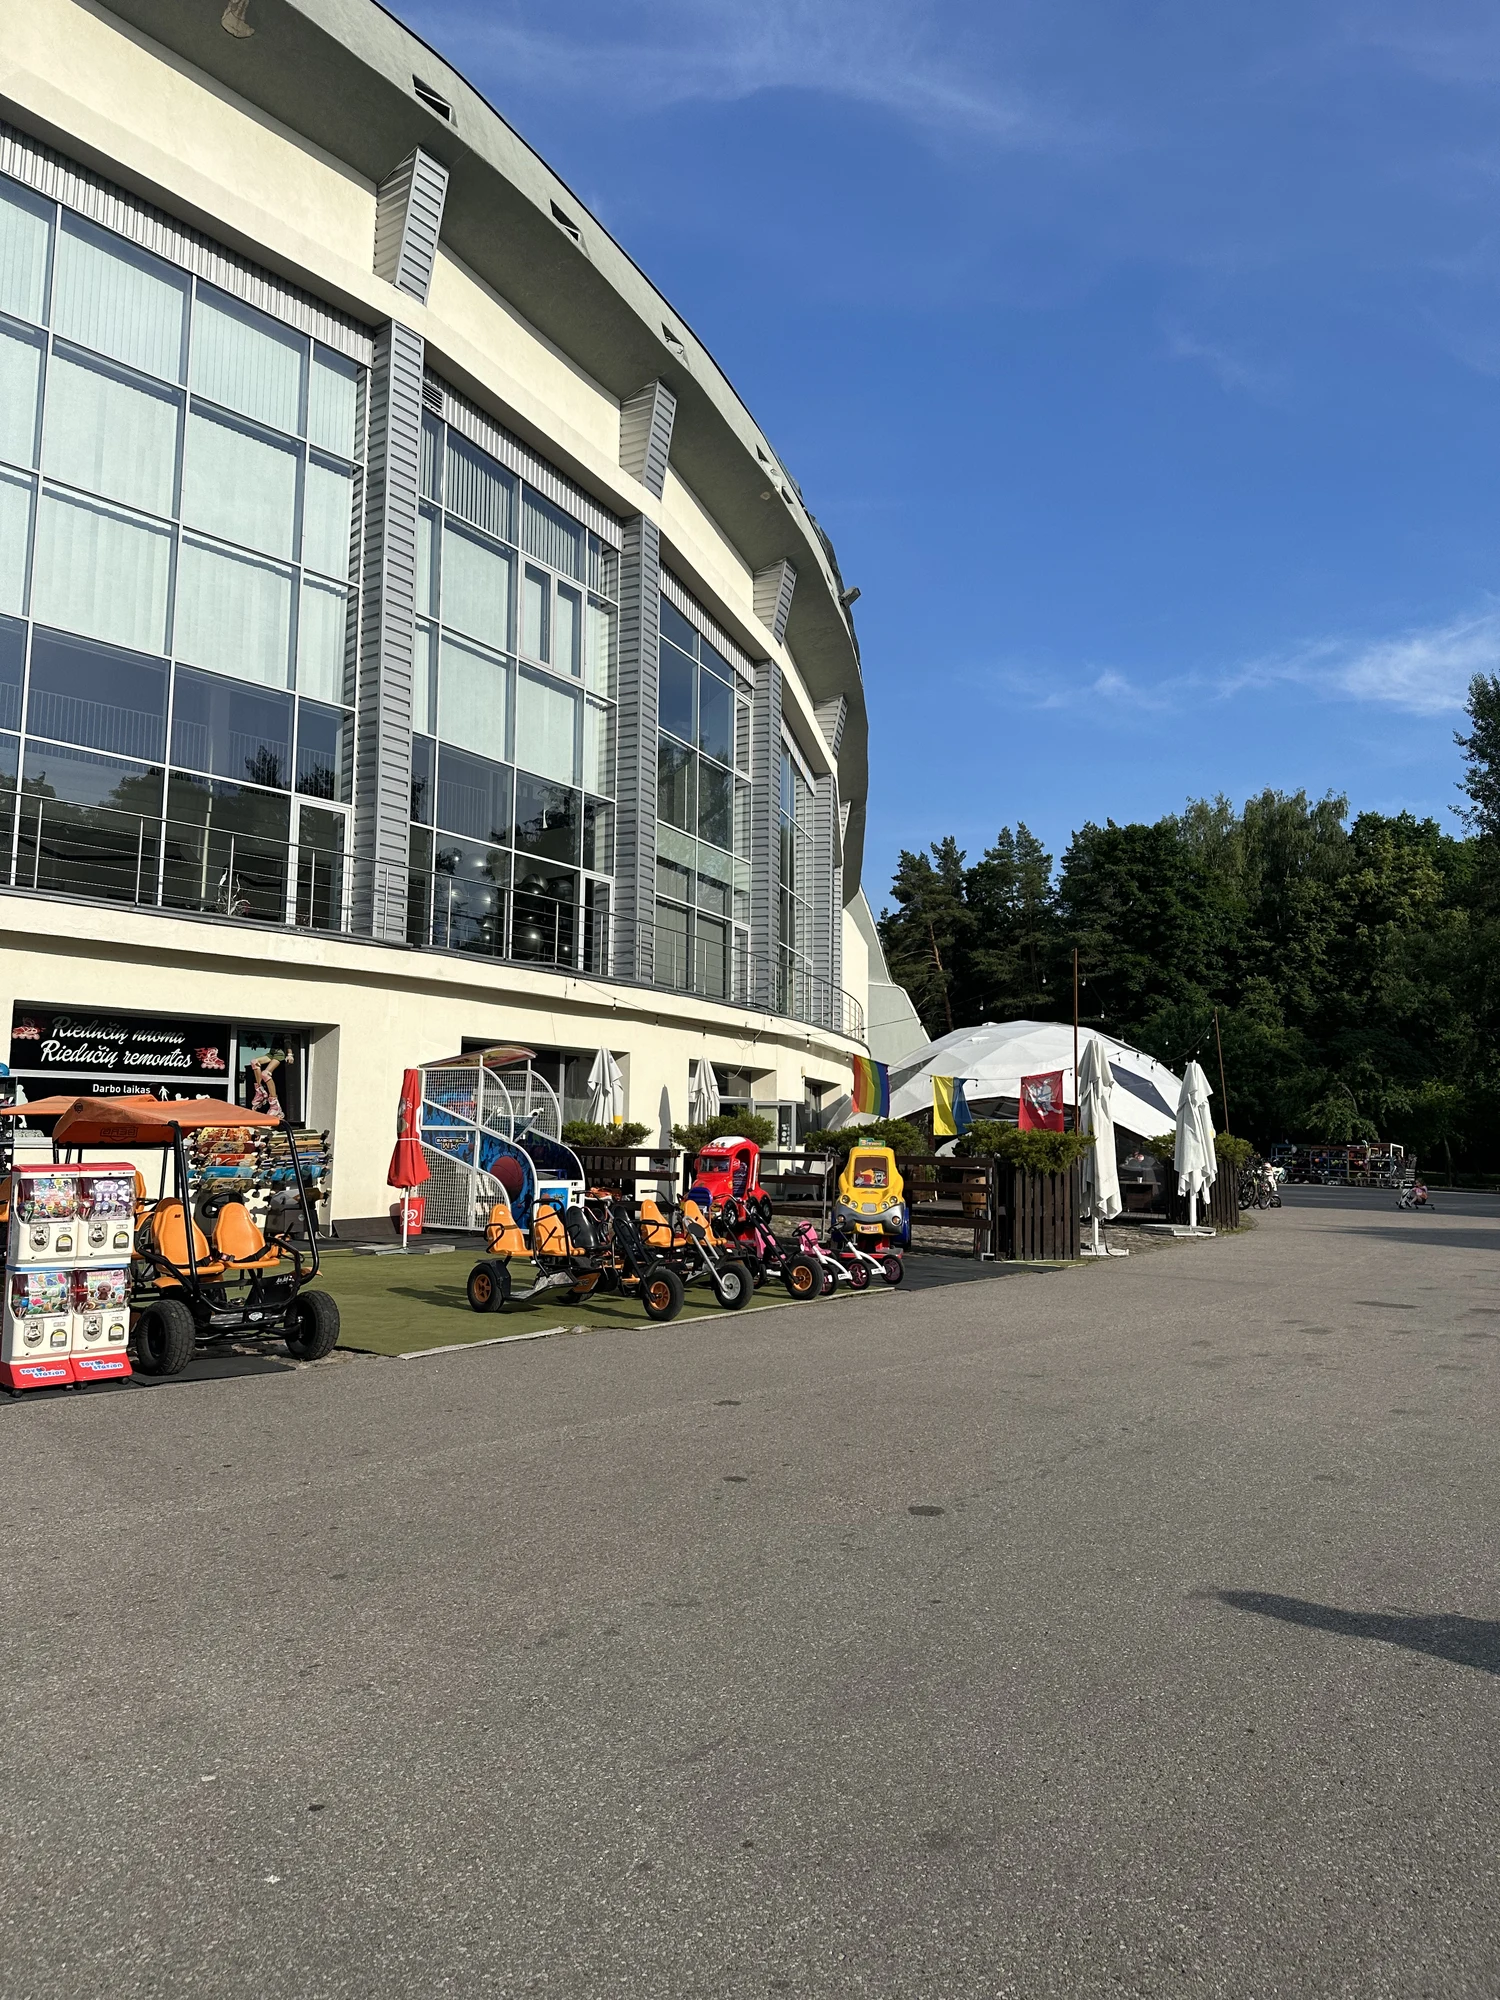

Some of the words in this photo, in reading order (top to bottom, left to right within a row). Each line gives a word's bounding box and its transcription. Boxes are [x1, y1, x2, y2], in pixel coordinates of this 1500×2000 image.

[52, 1016, 128, 1044] Riedučių
[132, 1029, 185, 1044] nuoma
[41, 1040, 118, 1068] Riedučių
[123, 1048, 192, 1068] remontas
[92, 1084, 121, 1094] Darbo
[123, 1085, 151, 1094] laikas
